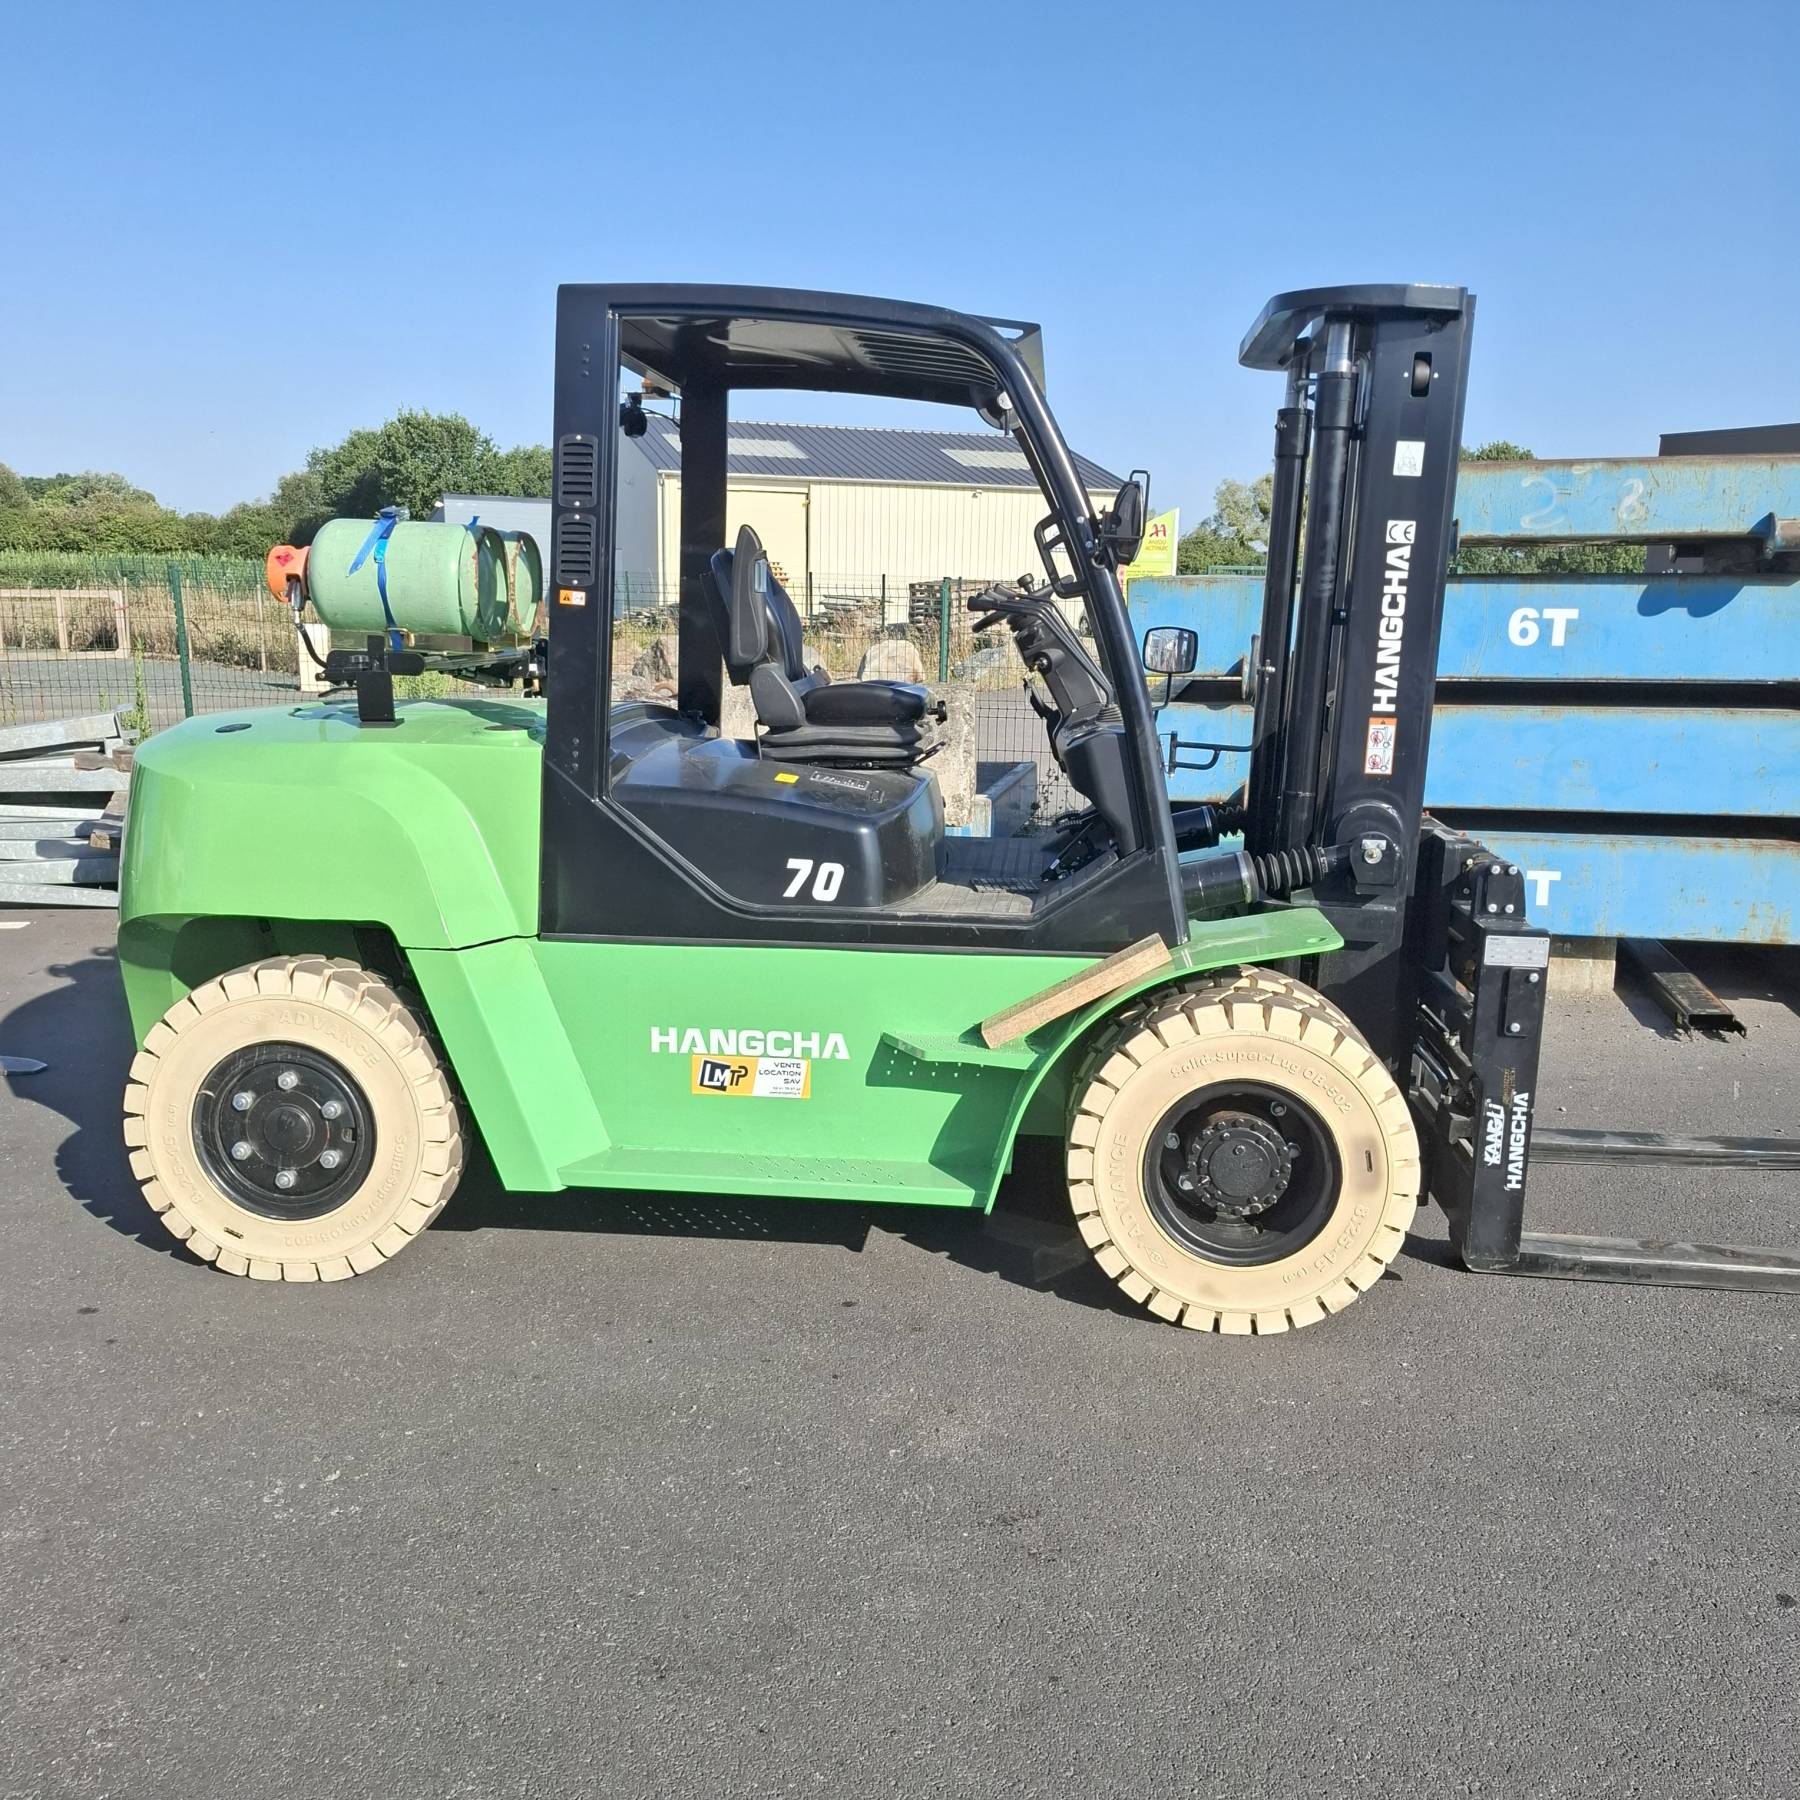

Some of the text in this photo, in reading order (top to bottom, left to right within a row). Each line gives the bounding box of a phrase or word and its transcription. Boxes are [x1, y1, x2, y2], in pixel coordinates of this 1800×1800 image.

[1388, 523, 1414, 542] CE
[1372, 544, 1412, 713] HANGCHA
[1508, 607, 1579, 647] 6T
[783, 858, 845, 902] 70
[279, 1009, 381, 1069] ADVANCE
[650, 1026, 851, 1060] HANGCHA
[758, 1069, 801, 1077] LOCATION
[1506, 1092, 1529, 1189] HANGCHA
[1110, 1133, 1144, 1239] ADVANCE
